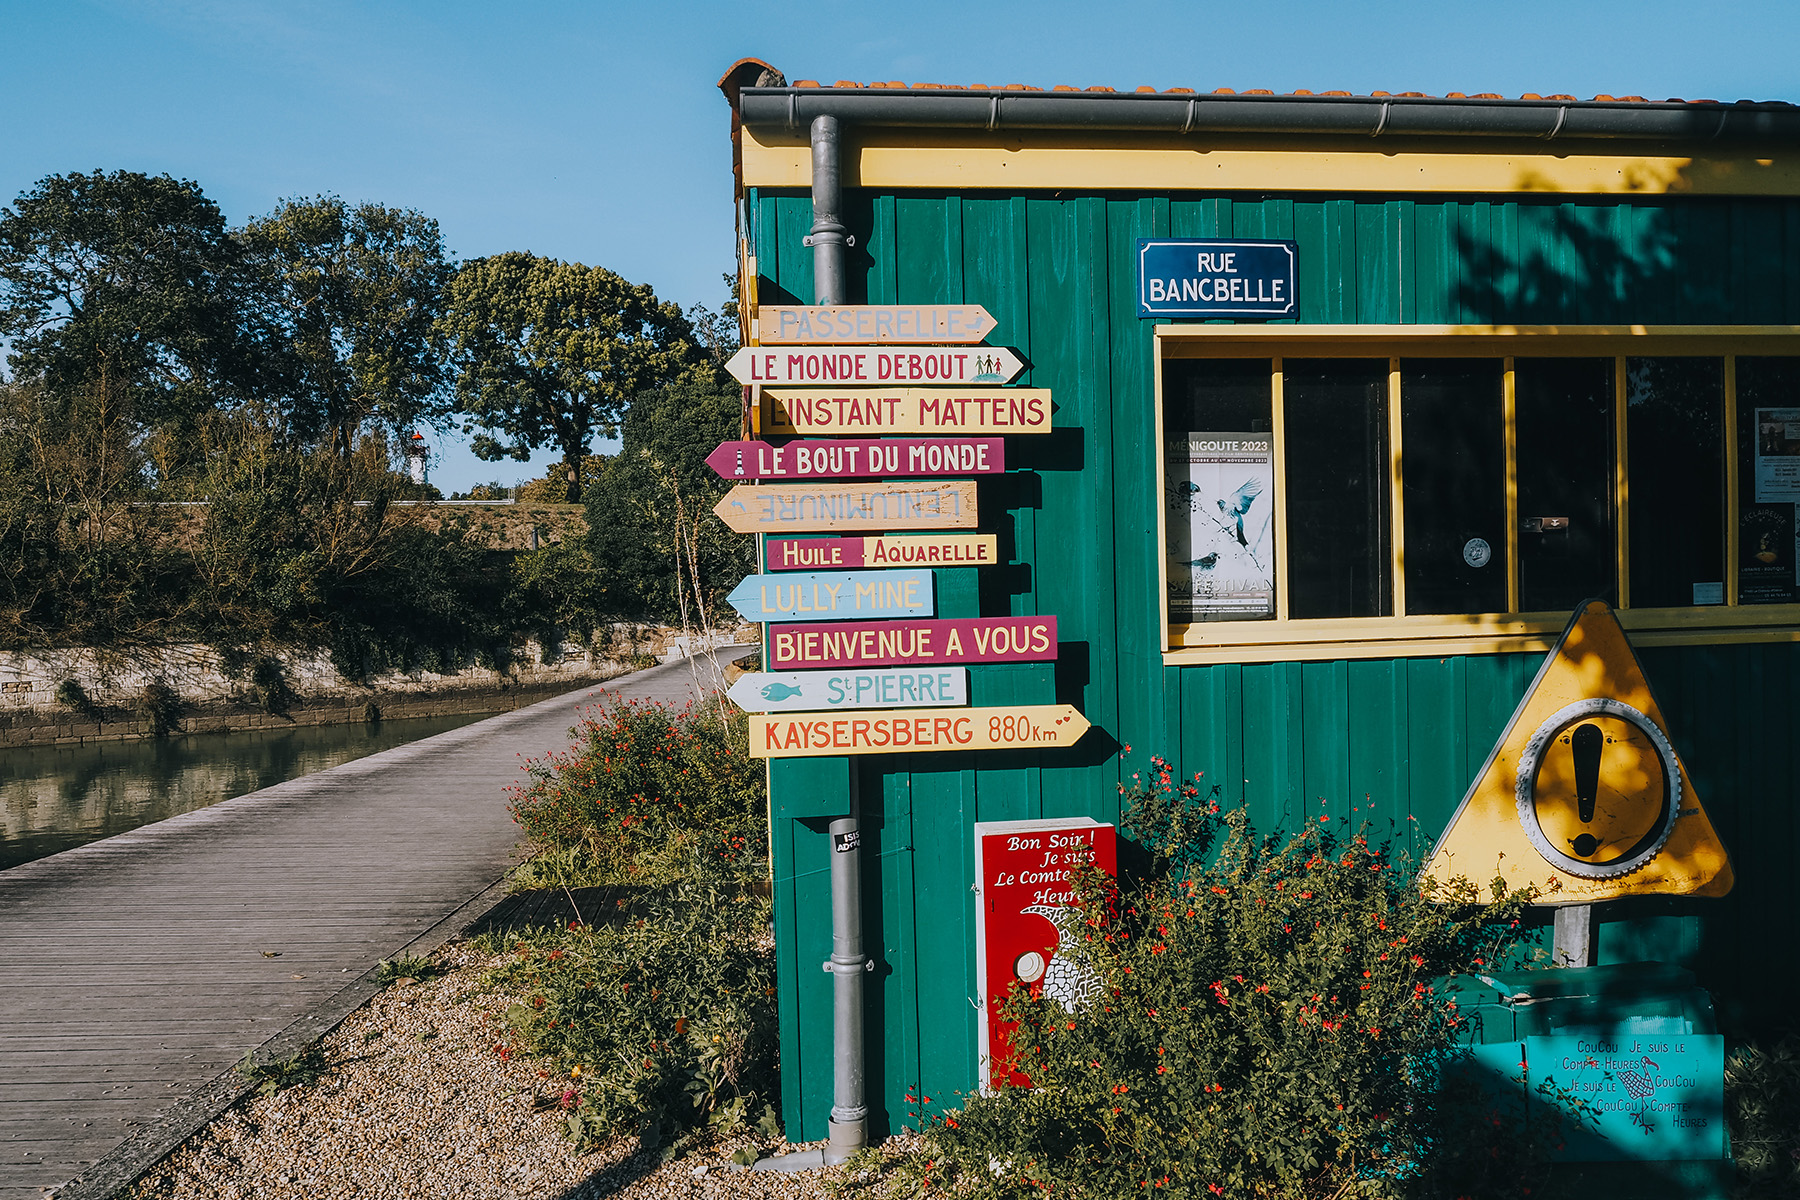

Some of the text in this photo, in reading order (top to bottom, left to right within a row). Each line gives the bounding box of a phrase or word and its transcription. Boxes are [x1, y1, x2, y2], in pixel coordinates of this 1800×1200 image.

[1198, 252, 1237, 273] RUE
[1149, 278, 1285, 302] BANCBELLE
[778, 310, 966, 339] PASSERELLE
[750, 354, 969, 380] LE MONDE DEBOUT
[770, 397, 1045, 426] L'INSTANT MATTENS
[758, 443, 991, 475] LE BOUT DU MONDE
[1169, 439, 1268, 451] MÉNIGOUTE 2023
[756, 490, 961, 522] L'ENLUMINURE
[760, 576, 923, 613] LULLY MINÉ
[775, 624, 1051, 662] BIENVENUE A VOUS
[855, 673, 955, 703] PIERRE
[764, 717, 974, 750] KAYSERSBERG
[1007, 836, 1041, 851] Bon
[1048, 832, 1084, 848] Soir
[1039, 851, 1059, 868] Je
[994, 872, 1015, 887] Le
